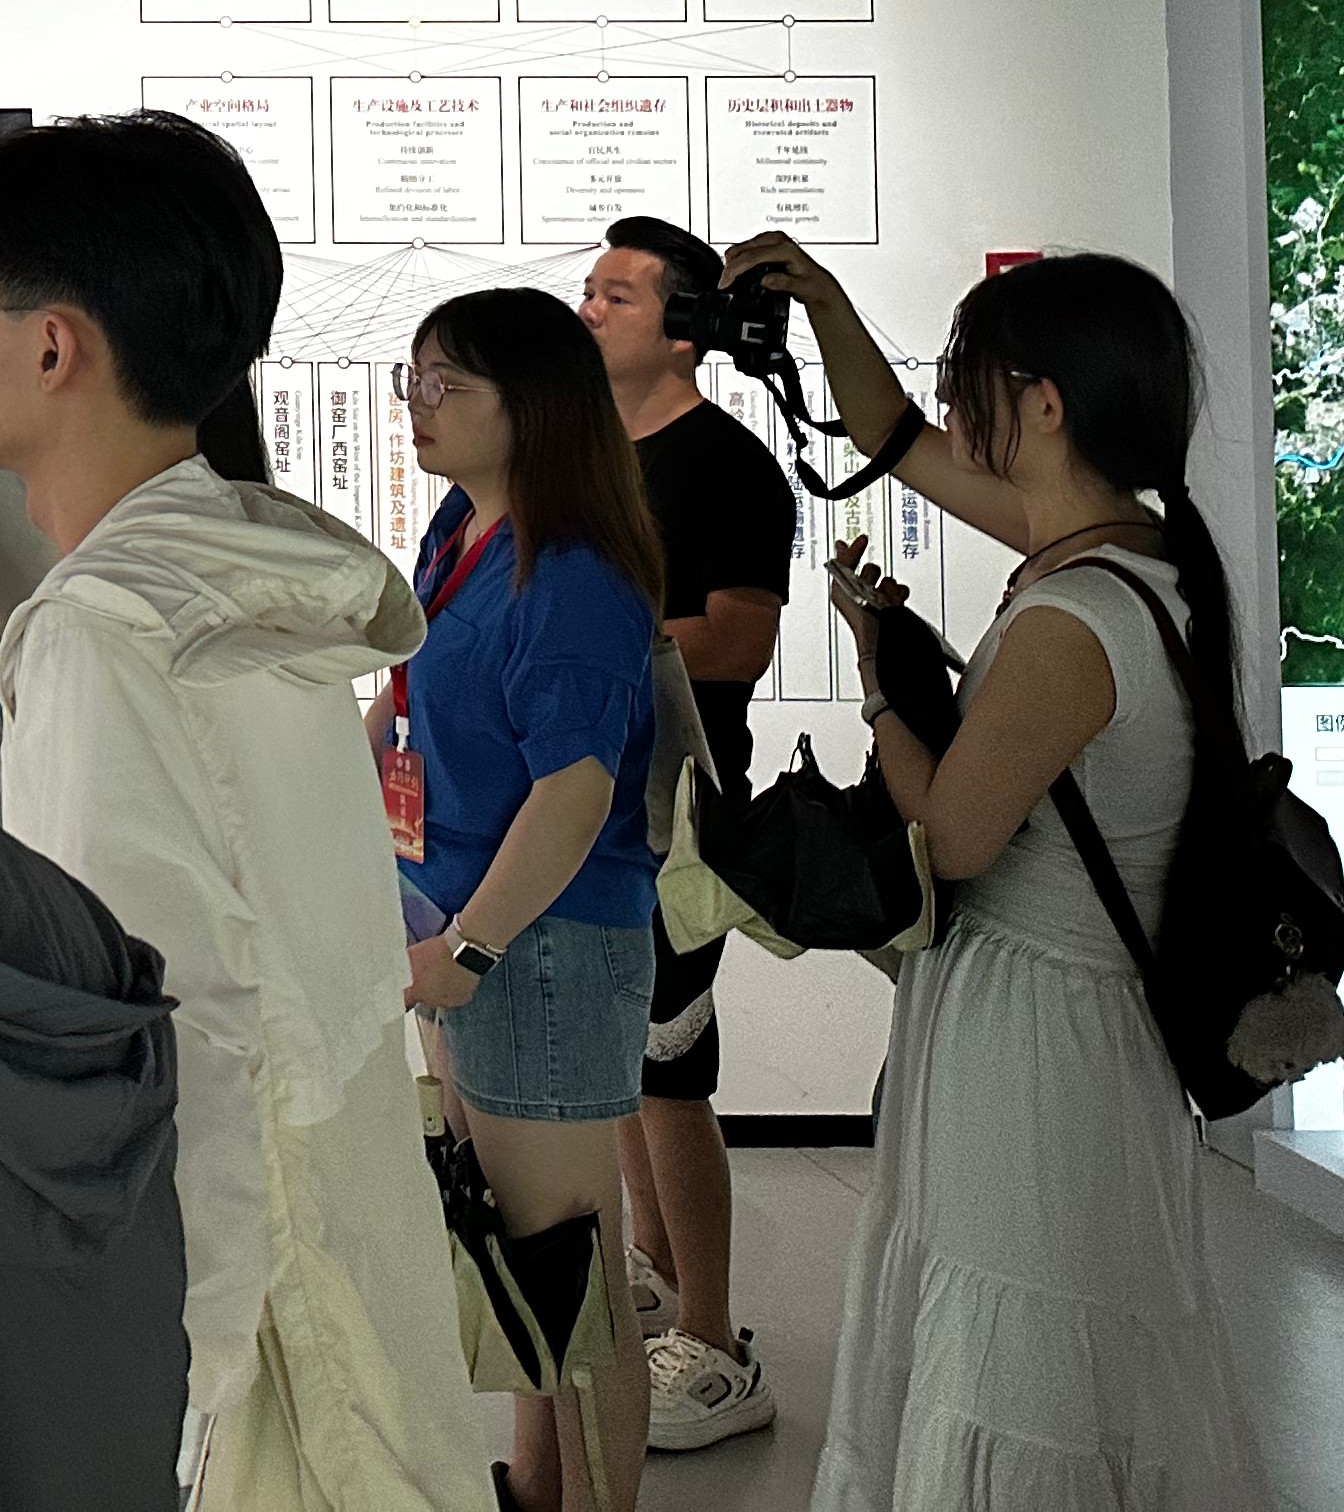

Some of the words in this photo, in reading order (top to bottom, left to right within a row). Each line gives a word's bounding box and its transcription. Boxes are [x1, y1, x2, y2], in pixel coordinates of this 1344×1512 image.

[352, 98, 480, 114] 生产设施及工艺技术
[541, 98, 667, 114] 生产和社会组织遗存
[273, 390, 291, 473] 观音阁窑址
[330, 390, 349, 490] 御窑厂西窑址
